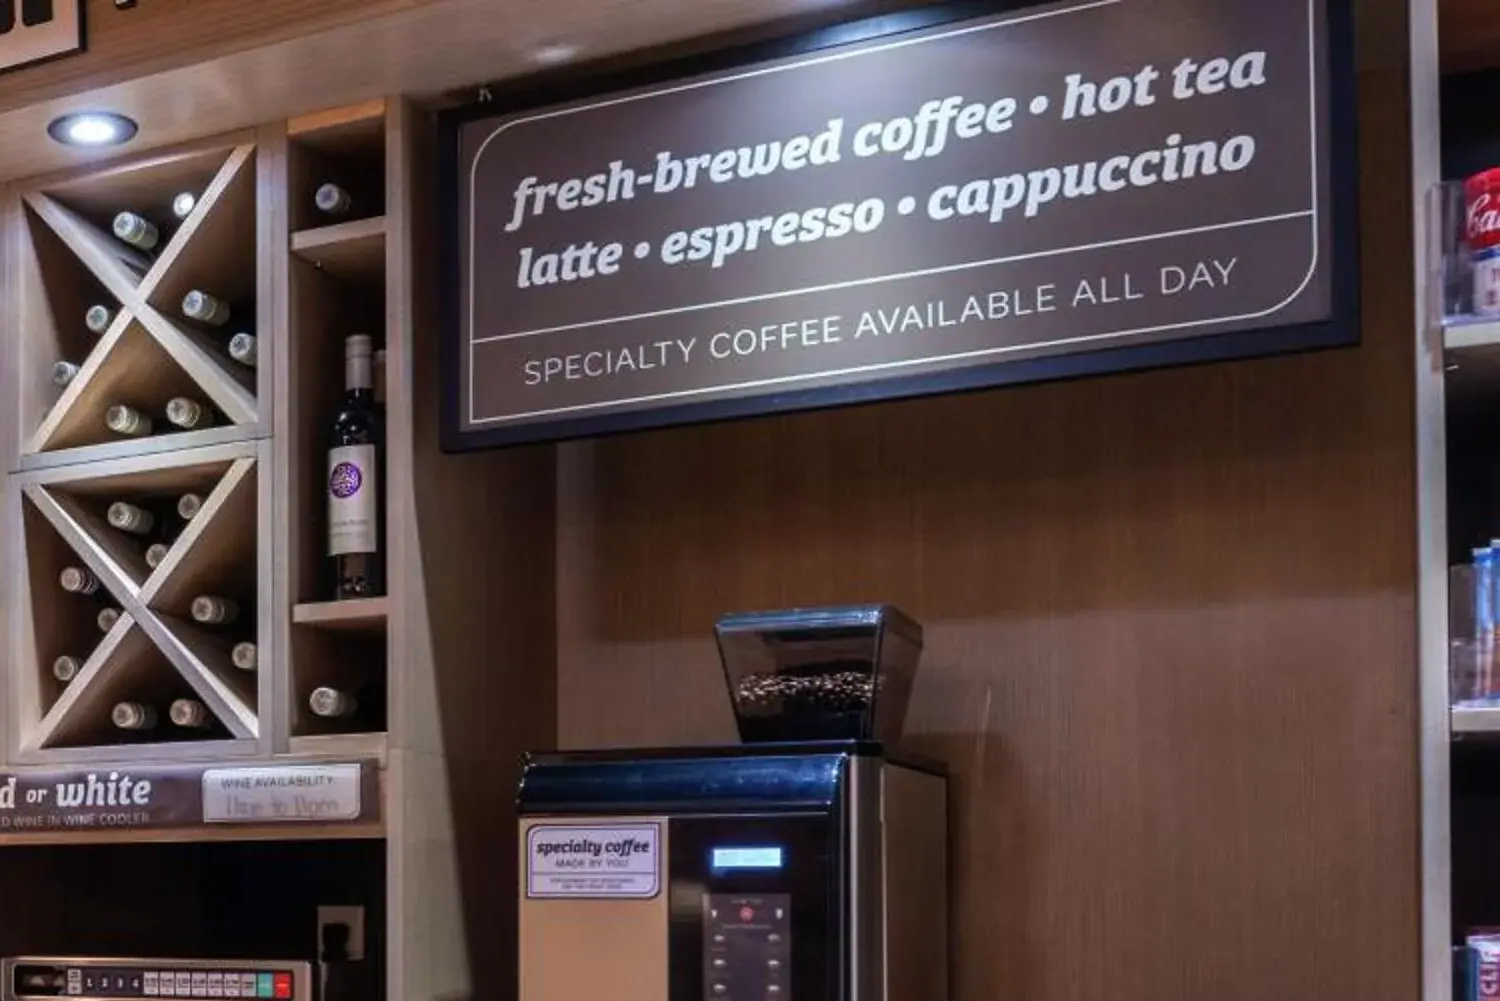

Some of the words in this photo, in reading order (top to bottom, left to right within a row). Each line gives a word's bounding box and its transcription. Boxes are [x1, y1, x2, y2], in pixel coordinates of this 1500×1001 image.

[506, 122, 842, 231] fresh-brewed
[852, 94, 1015, 162] coffee
[1062, 64, 1159, 121] hot
[1171, 49, 1267, 99] tea
[517, 241, 623, 289] latte
[660, 194, 886, 270] espresso
[927, 132, 1256, 223] cappuccino
[524, 337, 697, 386] SPECIALTY
[710, 314, 844, 360] COFFEE
[853, 283, 1057, 341] AVAILABLE
[1071, 272, 1144, 308] ALL
[1160, 256, 1238, 296] DAY
[25, 787, 48, 804] or
[55, 771, 151, 807] white
[220, 778, 251, 790] WINE
[13, 815, 44, 828] WINE
[64, 813, 96, 826] WINE
[100, 812, 150, 826] COOLER
[536, 838, 603, 857] specialty
[605, 837, 650, 857] coffee
